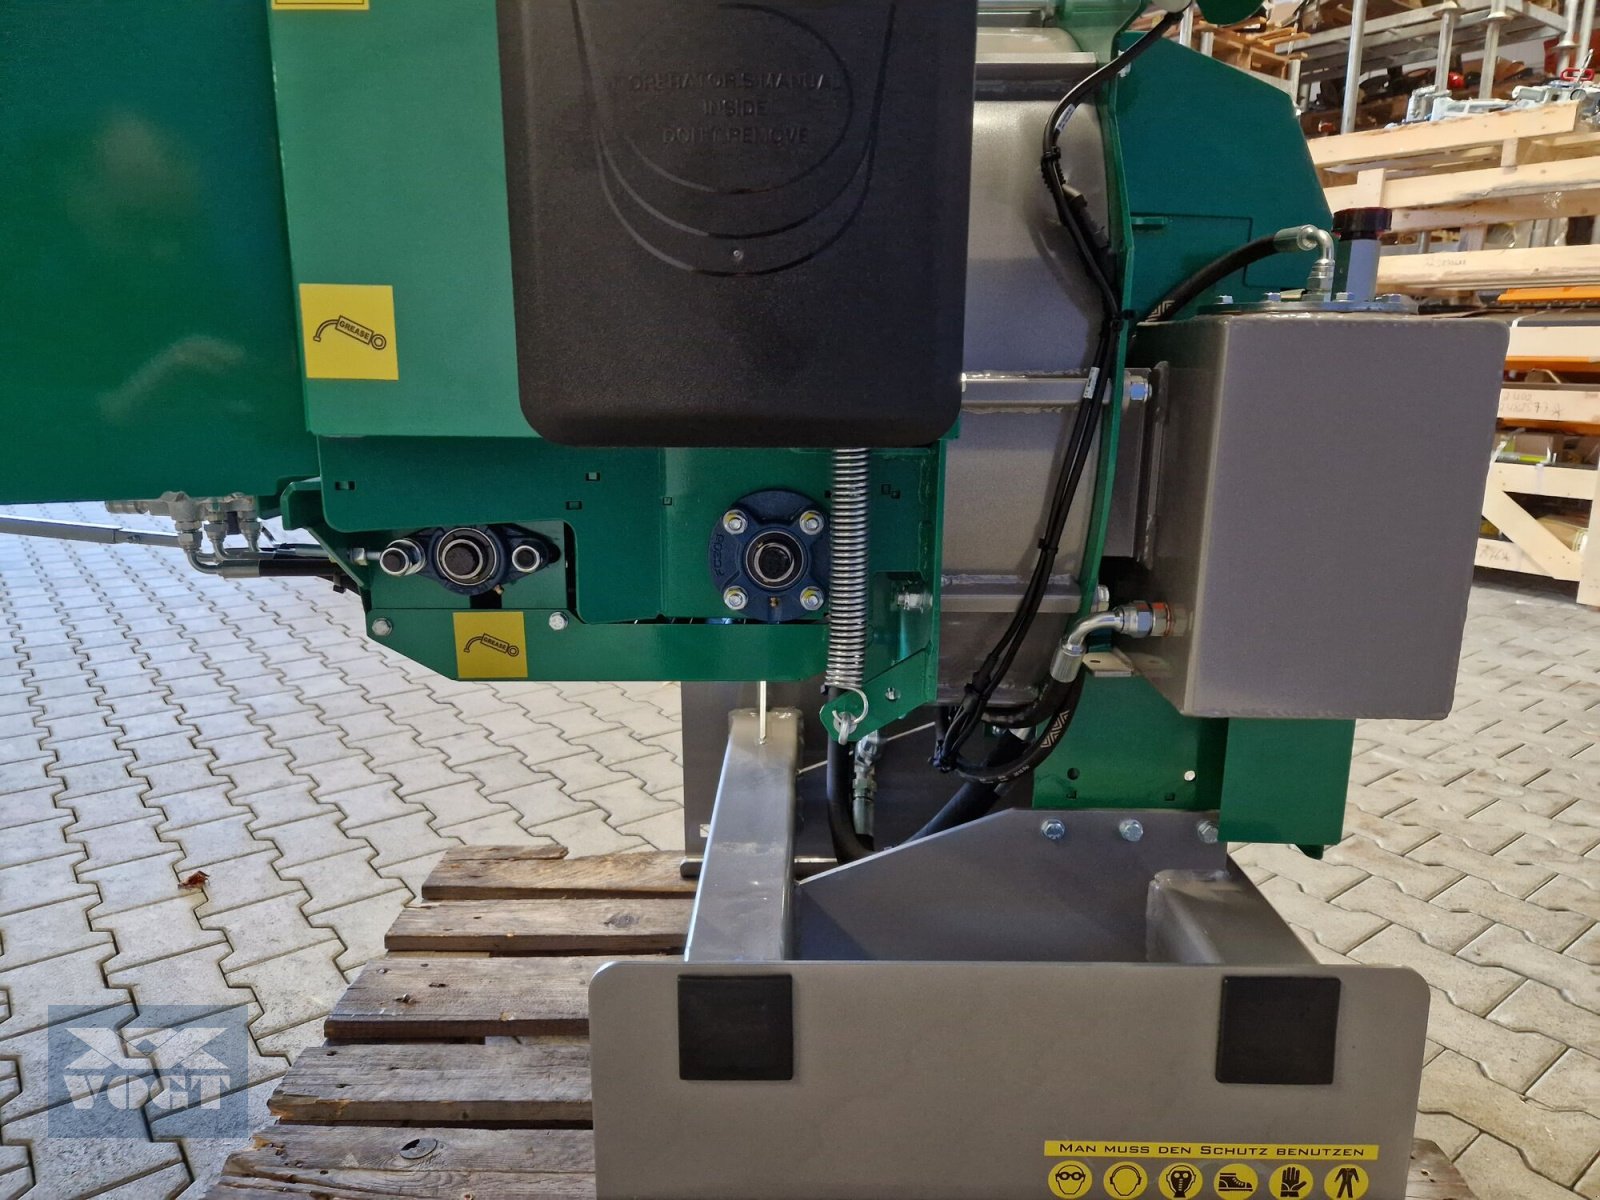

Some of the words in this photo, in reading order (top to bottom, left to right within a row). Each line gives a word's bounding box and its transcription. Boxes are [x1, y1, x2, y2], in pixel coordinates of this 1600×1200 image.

[758, 72, 842, 91] MANUAL
[702, 98, 769, 117] INSIDE
[725, 126, 809, 144] REMOVE
[339, 319, 371, 341] GREASE
[483, 636, 507, 651] GREASE
[1059, 1143, 1096, 1153] MAN
[1104, 1145, 1150, 1154] MUSS
[1158, 1146, 1192, 1154] DEN
[1200, 1145, 1268, 1156] SCHUTZ
[1276, 1148, 1364, 1157] BENUTZEN
